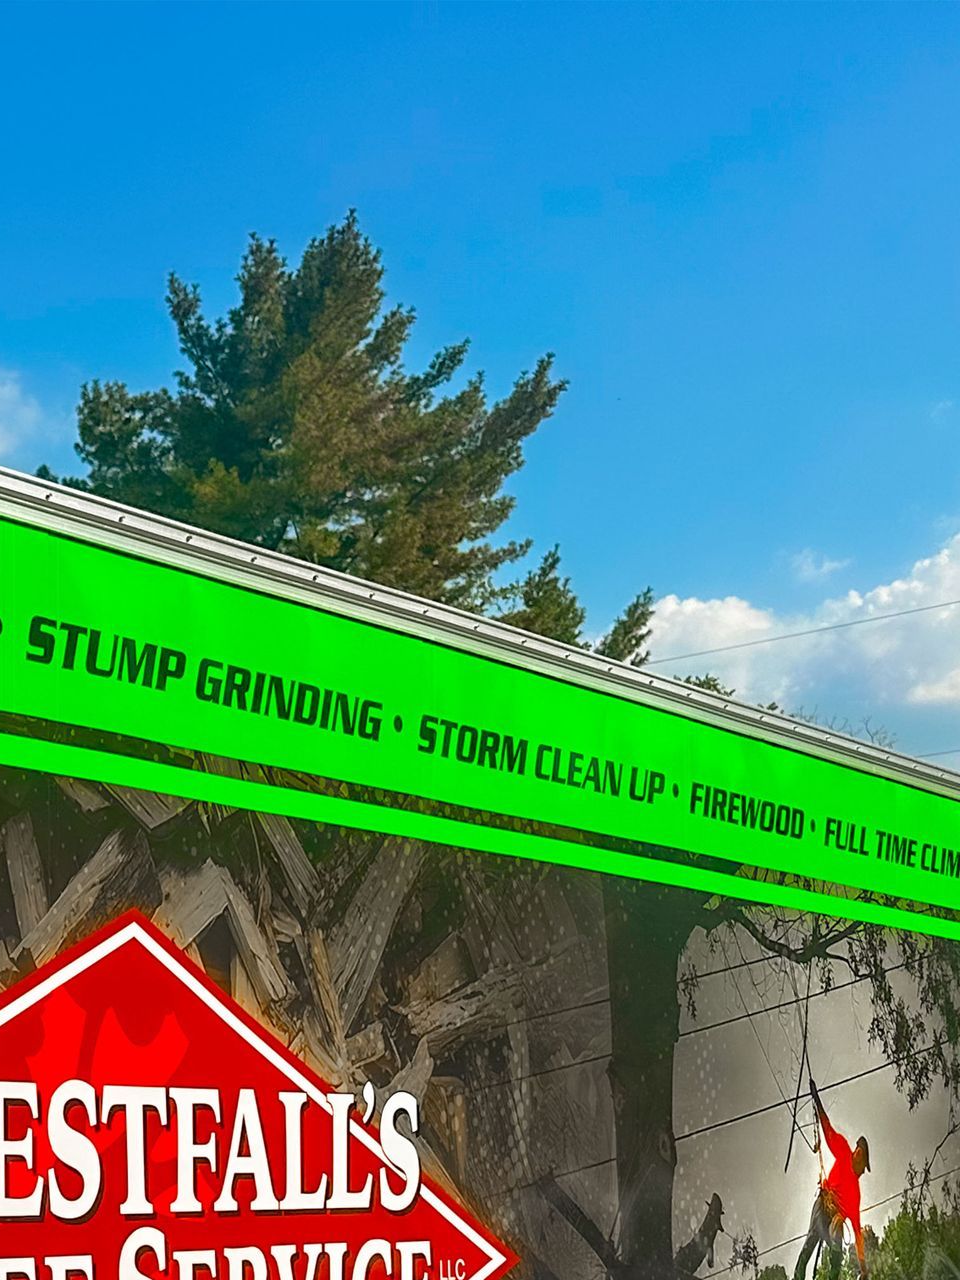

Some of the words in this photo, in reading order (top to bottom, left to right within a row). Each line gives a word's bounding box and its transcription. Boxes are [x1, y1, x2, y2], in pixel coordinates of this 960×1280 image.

[25, 615, 187, 692] STUMP
[195, 657, 383, 742] GRINDING
[417, 714, 529, 776] STORM
[534, 743, 624, 798] CLEAN
[628, 765, 666, 804] UP
[689, 781, 805, 840] FIREWOOD
[823, 816, 870, 857] FULL
[875, 829, 918, 868] TIME
[920, 843, 960, 879] CLIM
